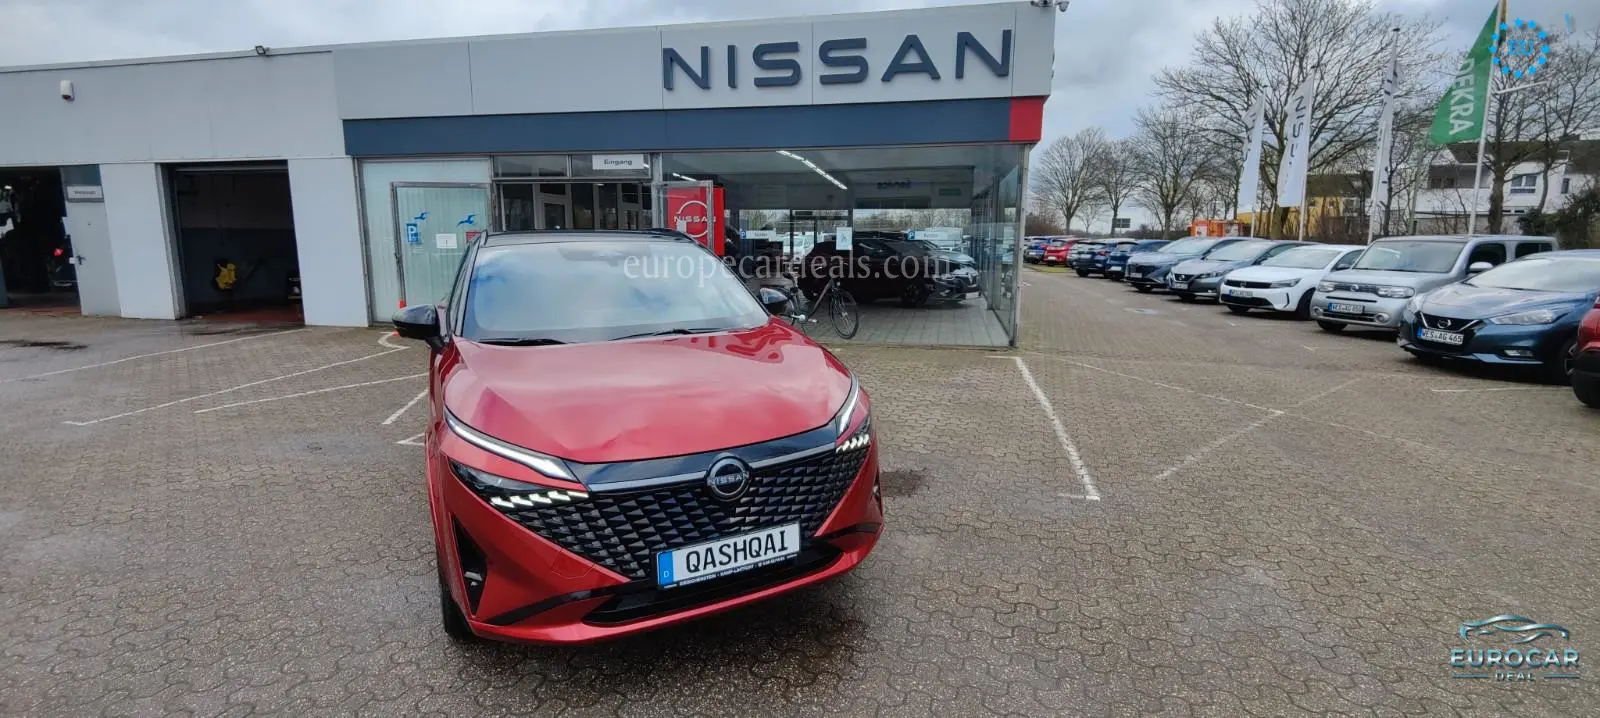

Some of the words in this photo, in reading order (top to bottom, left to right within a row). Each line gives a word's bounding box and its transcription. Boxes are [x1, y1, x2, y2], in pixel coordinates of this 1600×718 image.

[663, 29, 1012, 91] NISSAN
[1449, 58, 1475, 136] DEKRA
[603, 158, 633, 167] Eingang
[707, 471, 749, 486] NISSAN
[686, 531, 788, 573] QASHQAI
[663, 570, 670, 578] D
